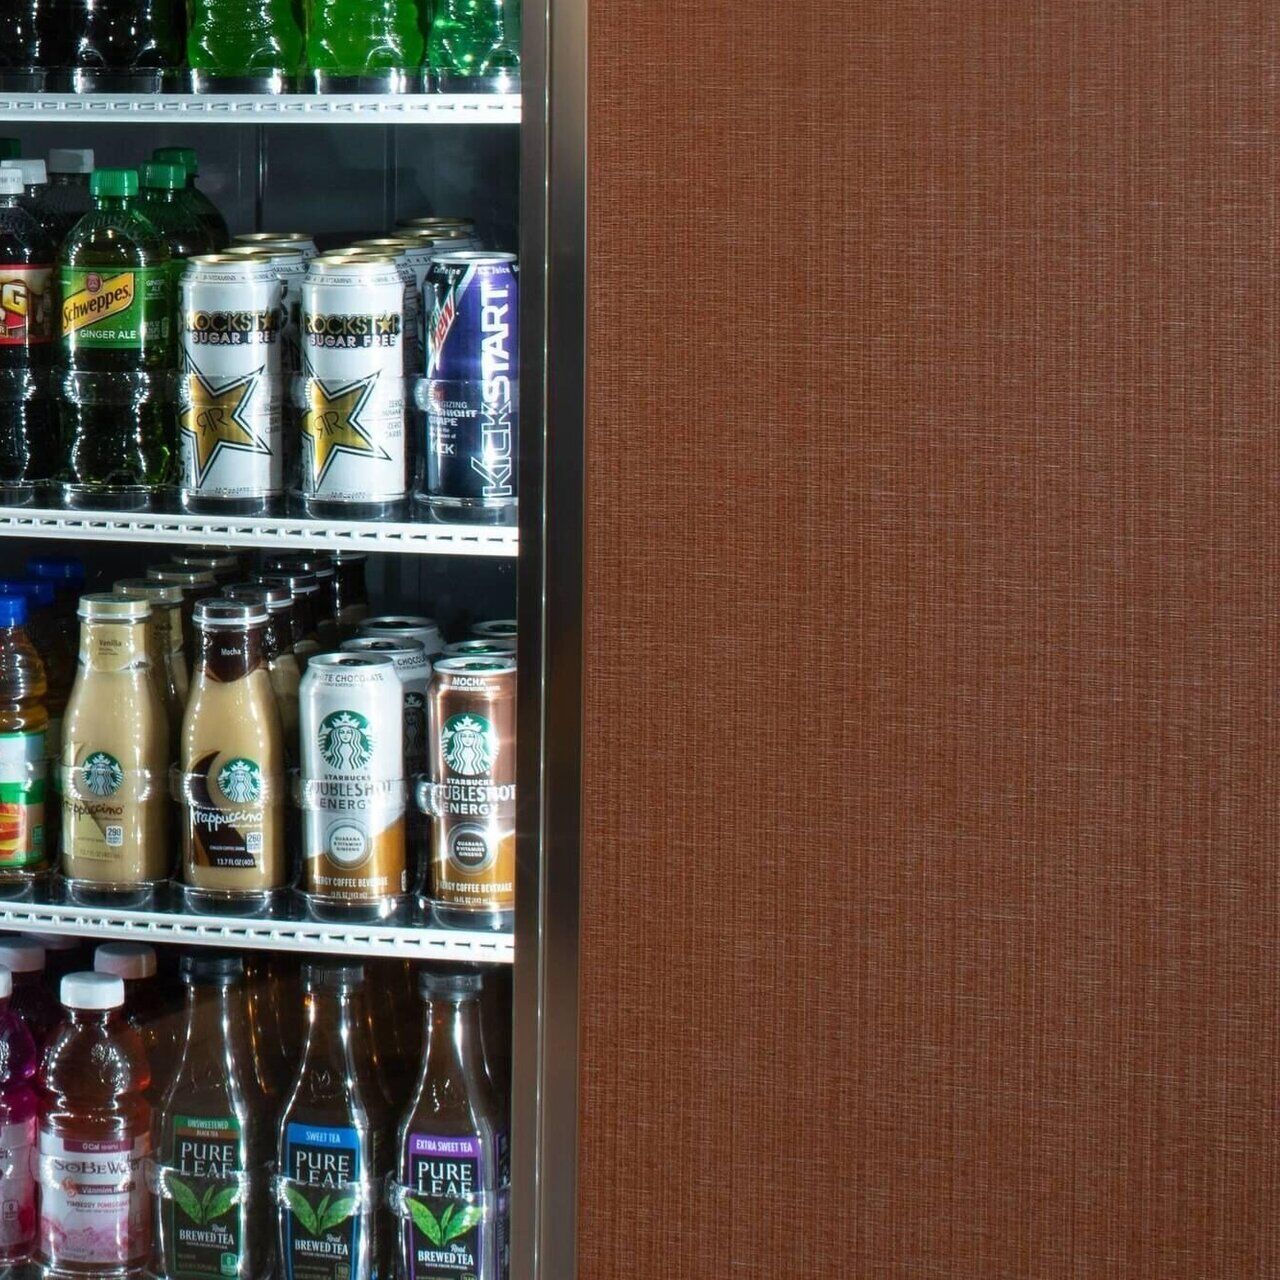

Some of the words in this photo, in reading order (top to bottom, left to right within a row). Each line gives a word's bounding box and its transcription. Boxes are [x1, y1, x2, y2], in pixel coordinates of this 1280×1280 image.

[80, 329, 117, 340] GINGER
[118, 330, 137, 340] ALE
[192, 332, 241, 344] SUGAR
[311, 333, 357, 347] SUGAR
[363, 334, 396, 347] FREE
[472, 283, 513, 498] KICKSTART
[99, 638, 122, 647] Vanilla
[221, 647, 241, 656] Mocha
[452, 677, 487, 687] MOCHA
[446, 778, 492, 786] STARBUCKS
[333, 878, 357, 887] COFFEE
[457, 881, 480, 891] COFFEE
[187, 1120, 229, 1130] UNSWEETENED
[306, 1131, 326, 1142] SWEET
[327, 1133, 340, 1143] TEA
[181, 1143, 234, 1162] PURE
[416, 1140, 433, 1151] EXTRA
[433, 1141, 456, 1152] SWEET
[457, 1143, 473, 1153] TEA
[295, 1151, 350, 1172] PURE
[181, 1161, 233, 1178] LEAF
[418, 1162, 472, 1181] PURE
[295, 1170, 348, 1188] LEAF
[82, 1185, 112, 1194] Vitamins
[418, 1180, 472, 1196] LEAF
[179, 1230, 215, 1243] BREWED
[216, 1232, 235, 1245] TEA
[294, 1239, 330, 1253] BREWED
[331, 1242, 348, 1255] TEA
[418, 1250, 454, 1263] BREWED
[454, 1253, 474, 1266] TEA
